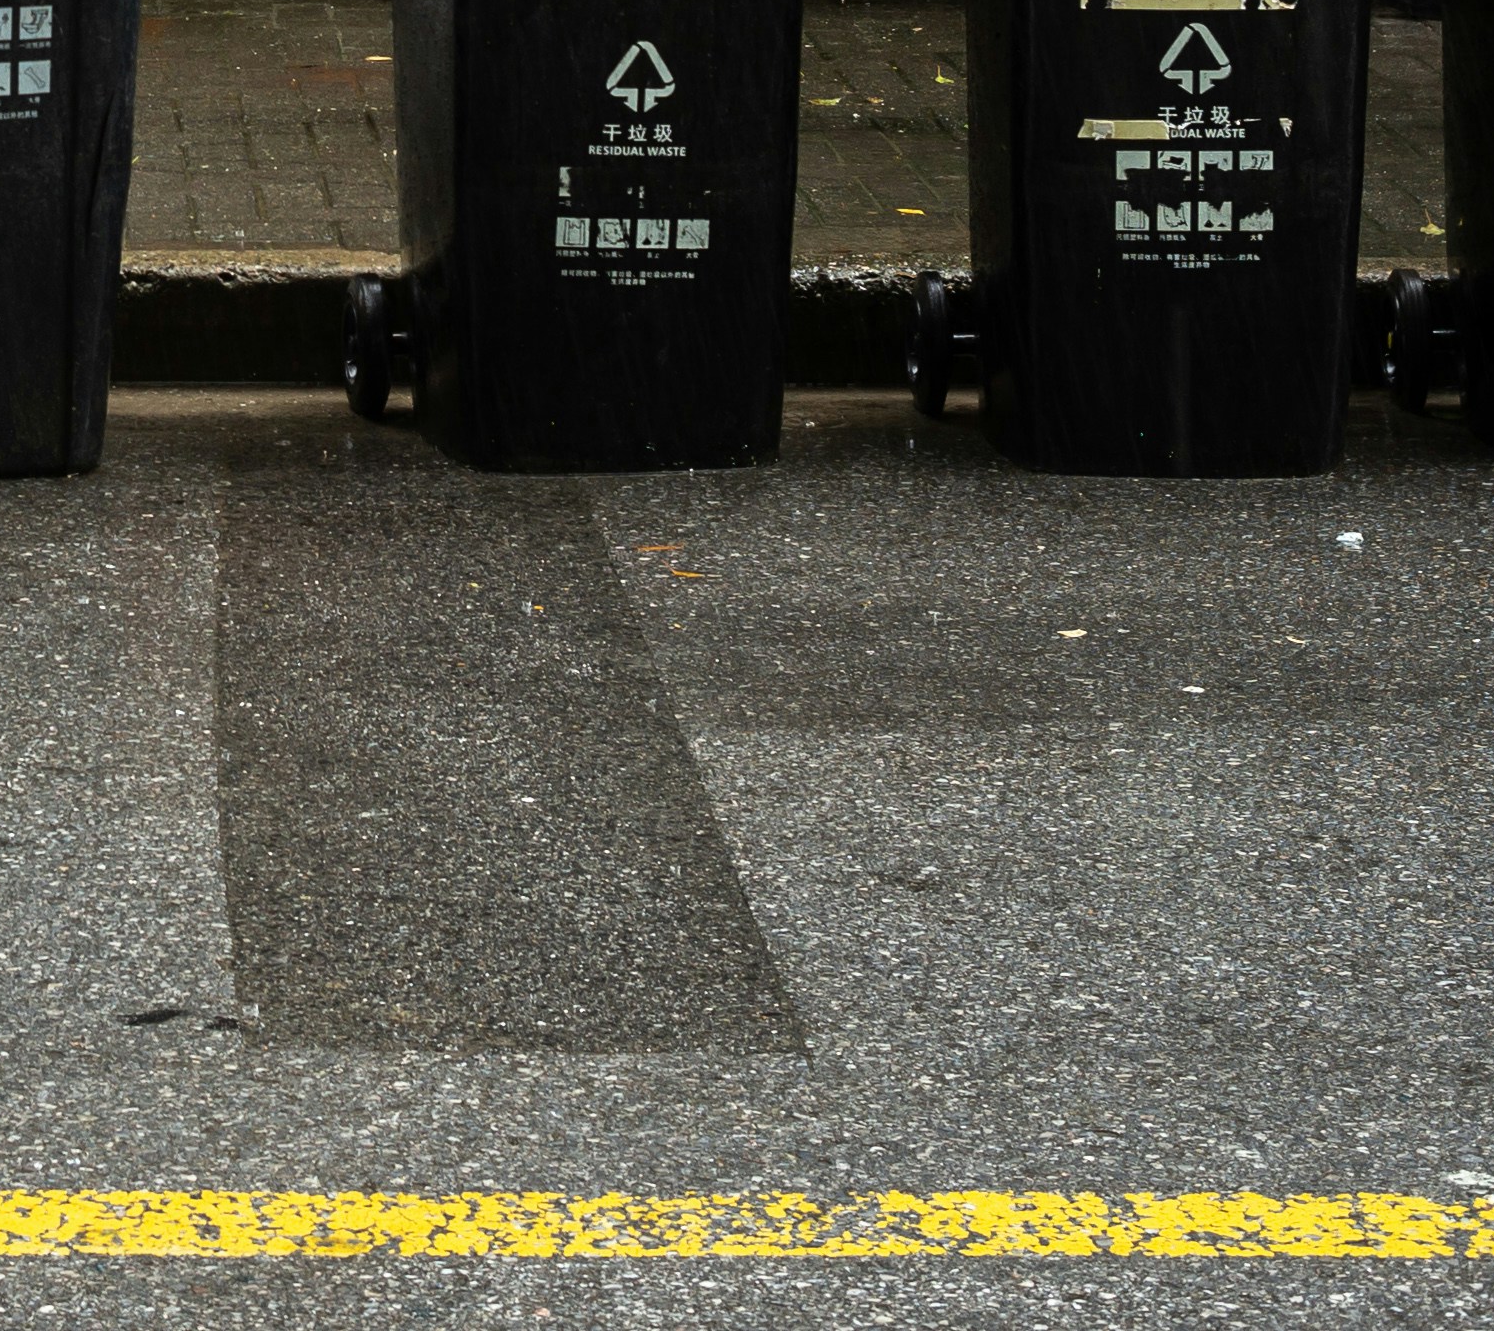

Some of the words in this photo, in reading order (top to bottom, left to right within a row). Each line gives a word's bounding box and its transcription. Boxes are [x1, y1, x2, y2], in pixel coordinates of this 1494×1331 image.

[1157, 106, 1231, 126] 干垃圾
[601, 123, 674, 143] 干垃圾
[1204, 128, 1246, 140] WASTE
[588, 144, 645, 157] RESIDUAL
[647, 145, 687, 157] WASTE
